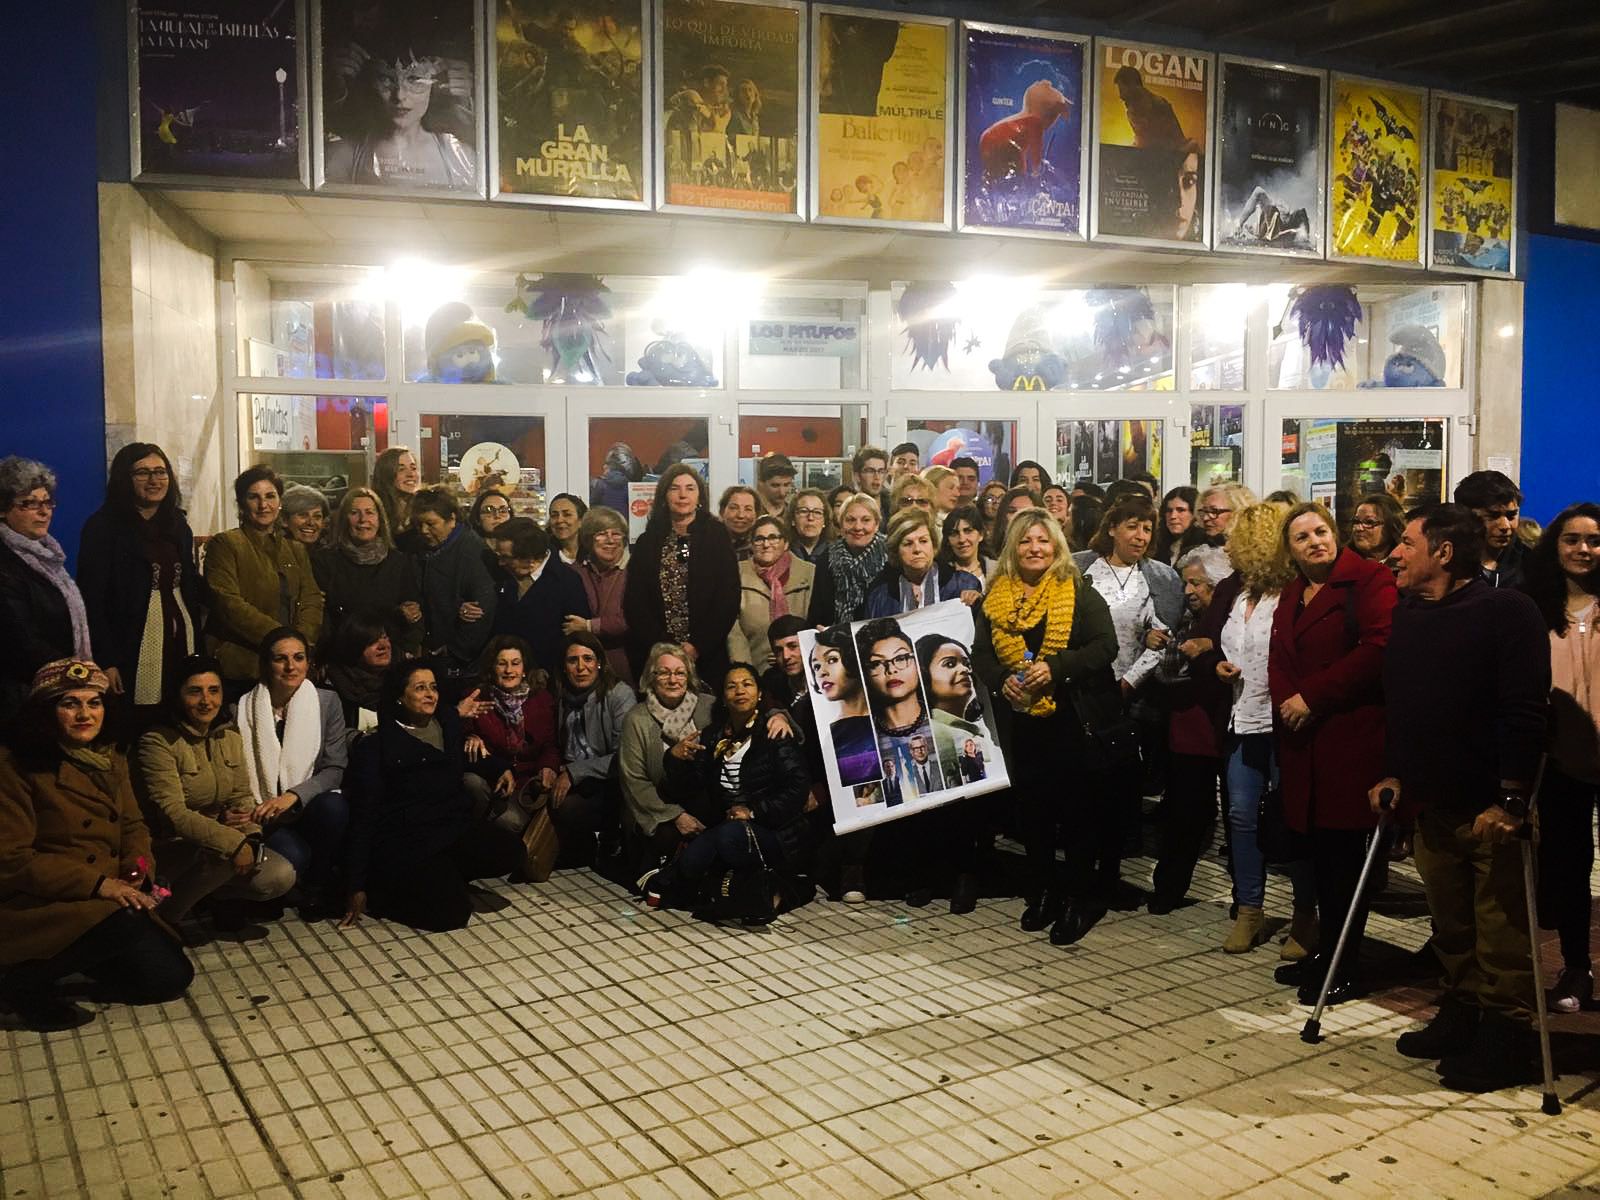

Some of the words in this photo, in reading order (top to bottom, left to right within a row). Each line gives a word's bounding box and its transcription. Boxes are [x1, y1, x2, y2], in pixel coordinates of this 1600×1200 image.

[1105, 46, 1204, 82] LOGAN
[558, 123, 590, 143] LA
[540, 140, 609, 162] GRAN
[516, 157, 632, 183] MURALLA
[750, 324, 784, 338] LOS
[788, 325, 857, 340] PITUFOS
